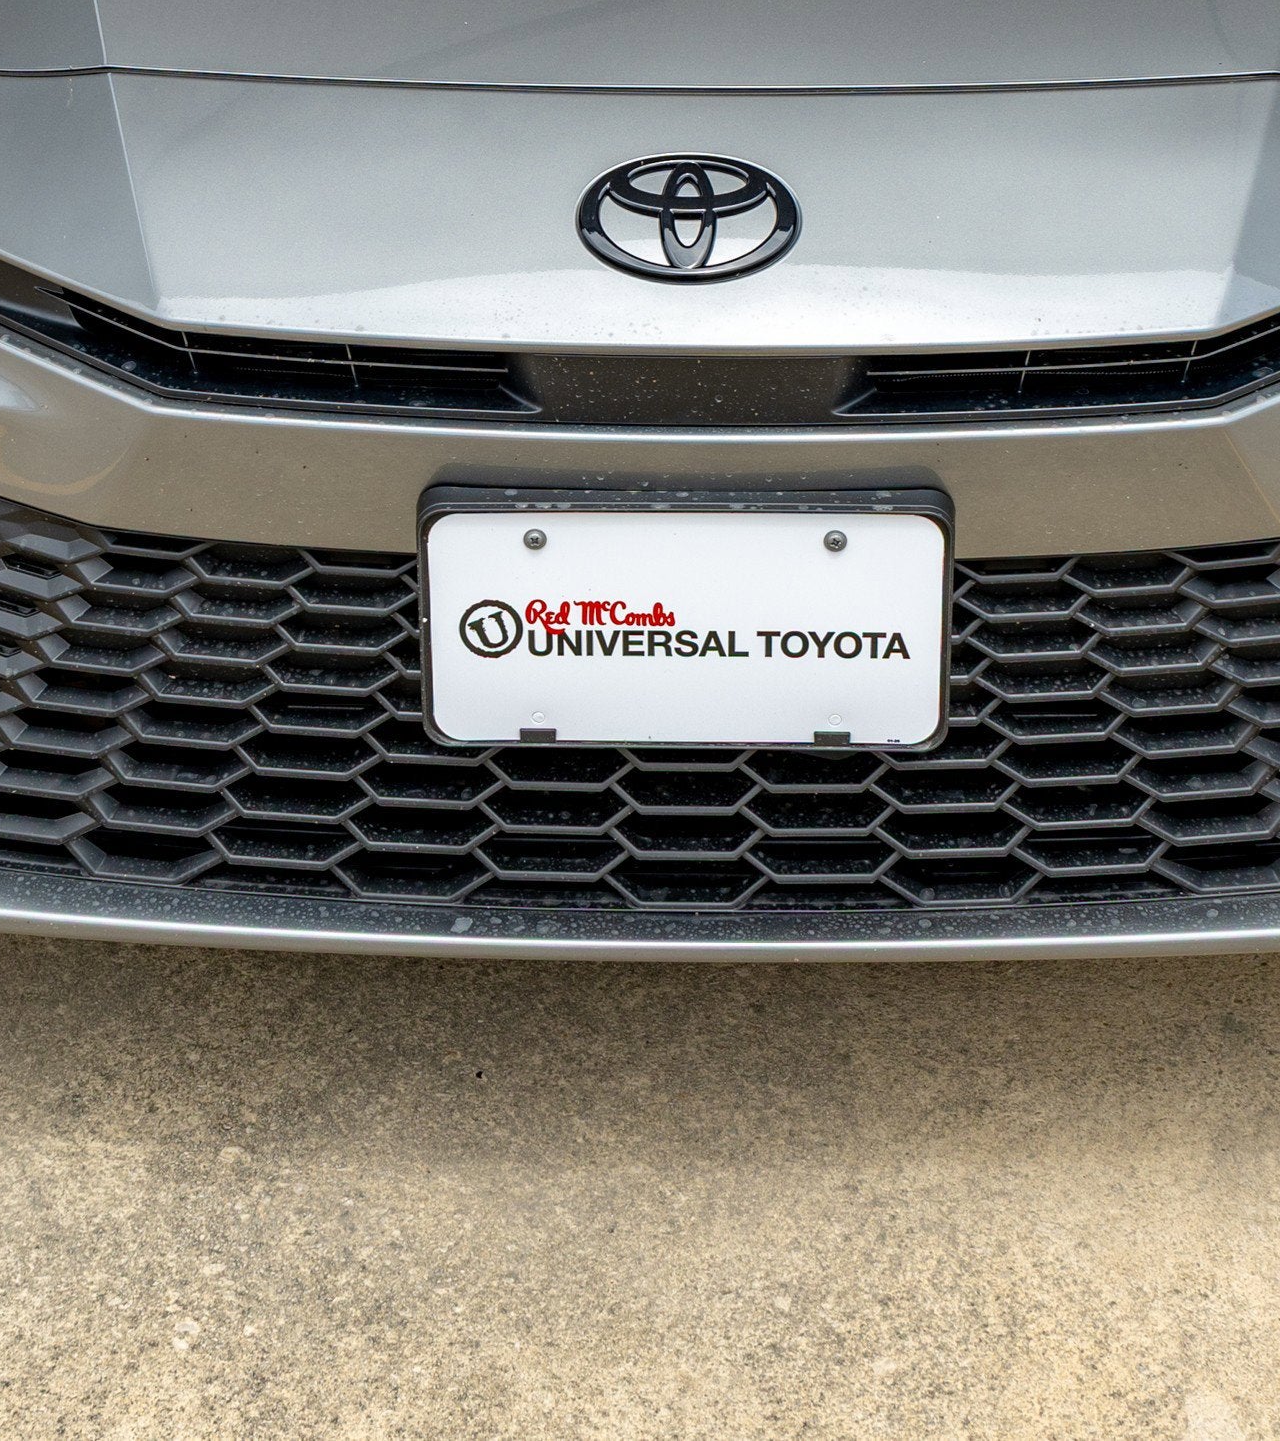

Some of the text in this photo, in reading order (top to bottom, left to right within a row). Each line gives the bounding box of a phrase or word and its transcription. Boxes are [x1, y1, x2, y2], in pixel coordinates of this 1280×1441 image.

[525, 599, 676, 635] Red McCombs
[527, 629, 911, 660] UNIVERSAL TOYOTA
